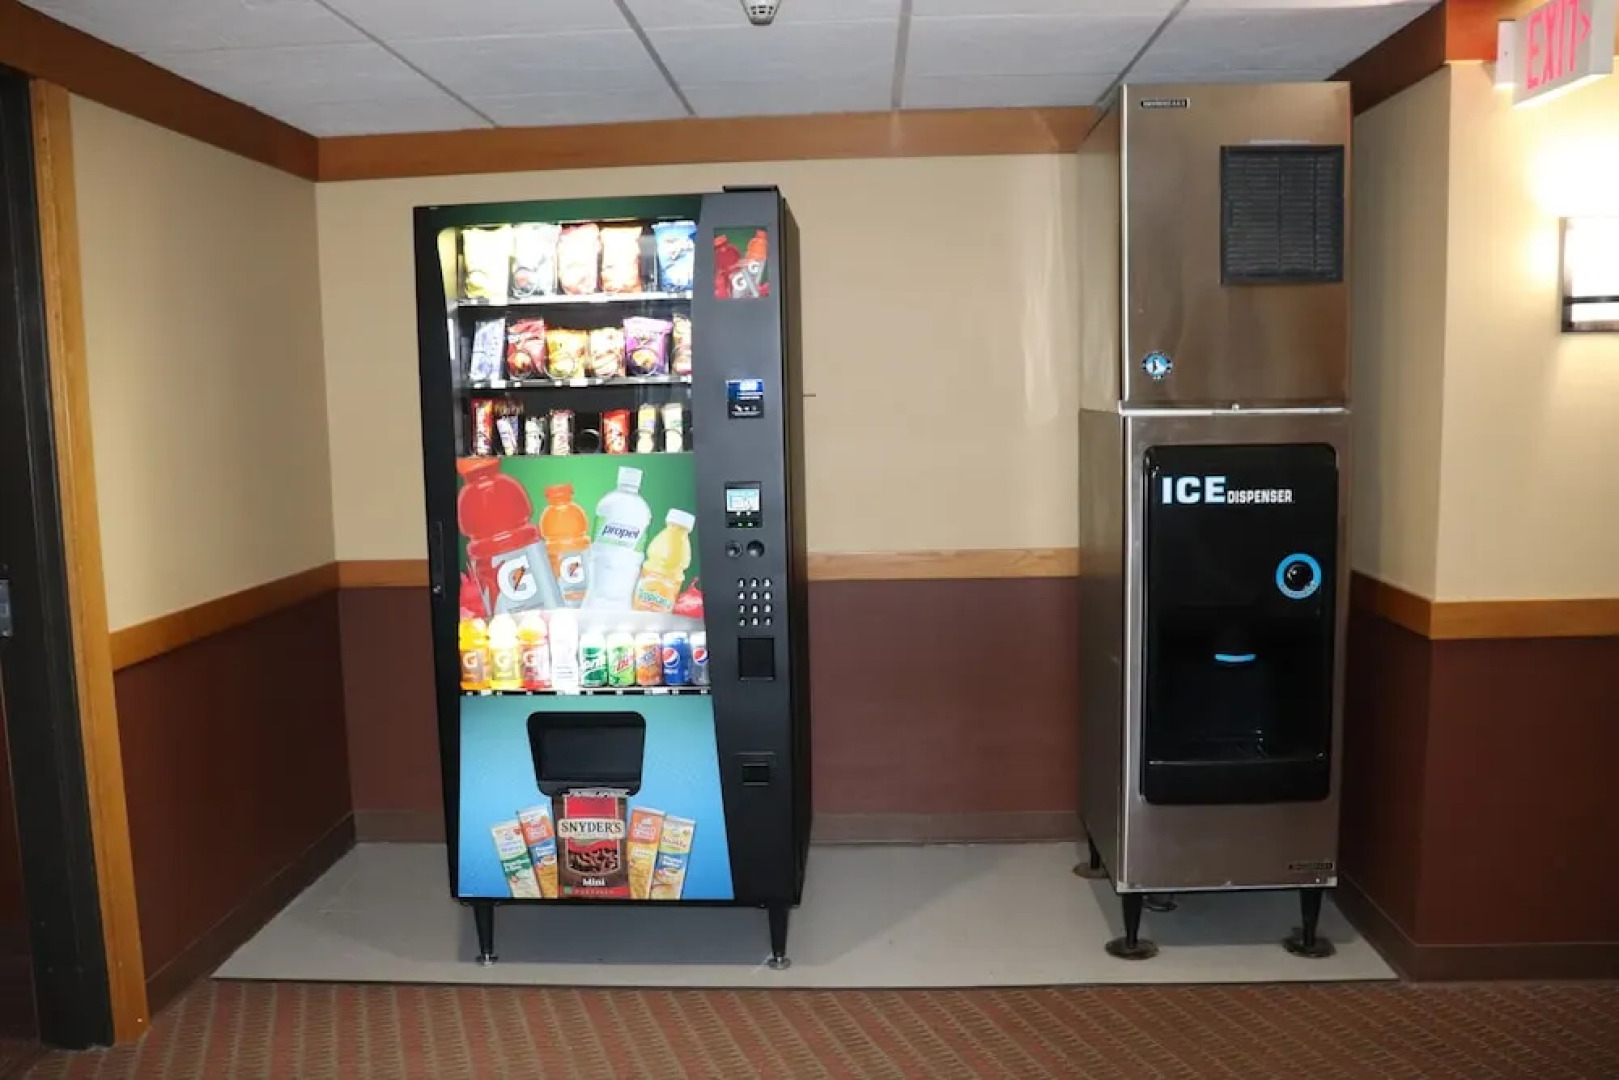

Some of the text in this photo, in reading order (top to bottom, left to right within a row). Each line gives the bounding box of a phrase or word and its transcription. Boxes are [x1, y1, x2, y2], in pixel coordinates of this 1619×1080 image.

[1525, 0, 1579, 89] EXIT
[1162, 475, 1293, 504] ICE DISPENSER
[602, 525, 640, 539] propel
[497, 555, 537, 601] G
[560, 555, 584, 583] G
[561, 821, 622, 834] SNYDER'S
[582, 877, 605, 887] Mini
